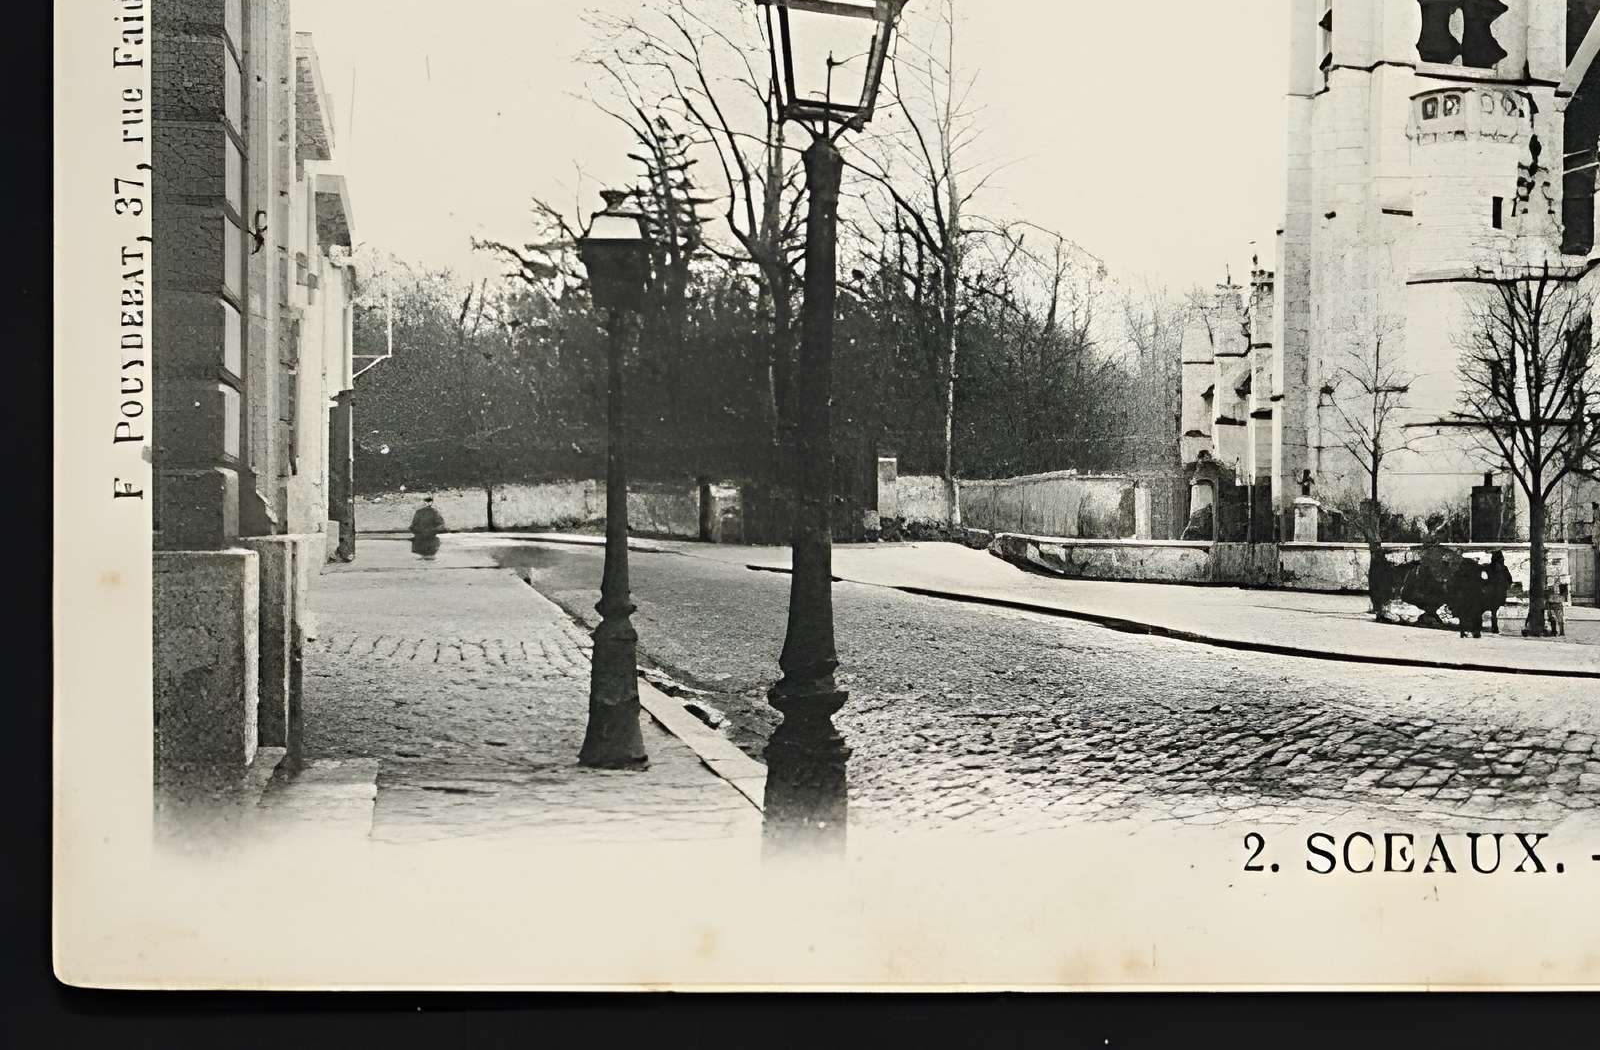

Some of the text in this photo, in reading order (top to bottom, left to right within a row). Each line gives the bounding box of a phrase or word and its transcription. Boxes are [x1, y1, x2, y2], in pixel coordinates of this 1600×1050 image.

[123, 89, 143, 142] rue
[114, 164, 150, 216] 37,
[1244, 832, 1279, 872] 2.
[1307, 832, 1564, 874] SCEAUX.
